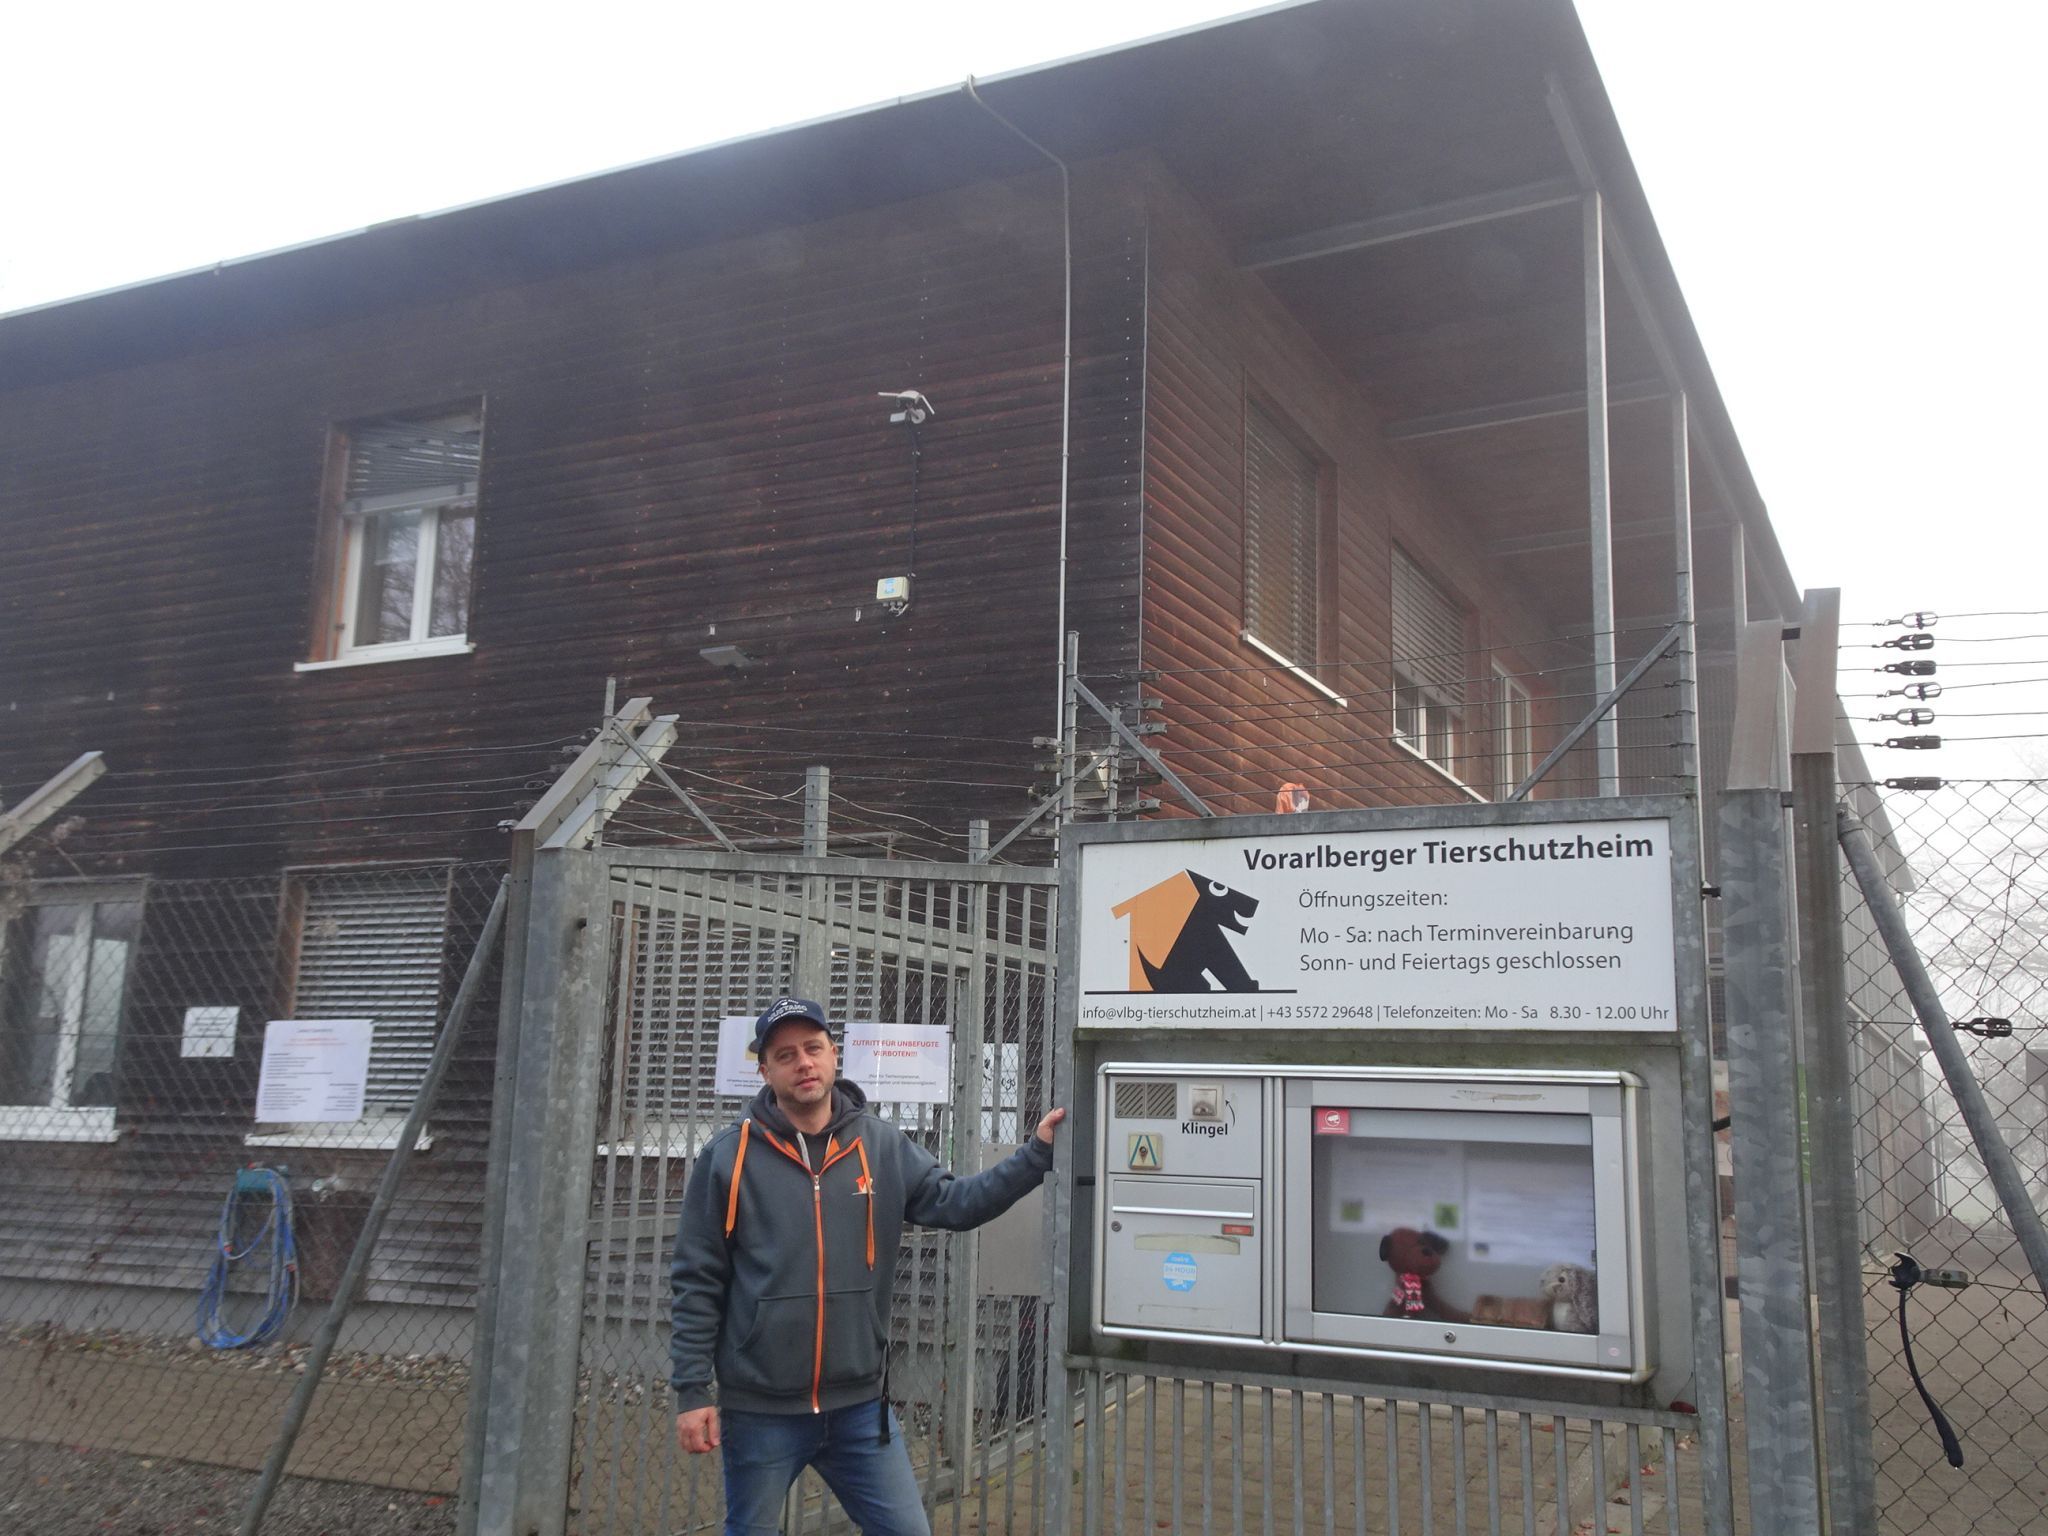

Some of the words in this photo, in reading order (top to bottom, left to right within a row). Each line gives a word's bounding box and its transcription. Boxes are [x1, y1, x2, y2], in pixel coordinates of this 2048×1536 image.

[1243, 841, 1418, 873] Vorarlberger
[1422, 834, 1654, 866] Tierschutzheim
[1298, 888, 1448, 912] Öffnungszeiten:
[1300, 928, 1329, 944] Mo
[1346, 926, 1373, 943] Sa:
[1377, 924, 1423, 943] nach
[1426, 922, 1634, 944] Terminvereinbarung
[1300, 955, 1355, 972] Sonn-
[1359, 953, 1396, 971] und
[1402, 953, 1490, 975] Feiertags
[1496, 951, 1622, 975] geschlossen
[1082, 1005, 1257, 1022] info@vlbg-tierschutzheim.at
[1267, 1005, 1292, 1019] +43
[1295, 1005, 1328, 1019] 5572
[1331, 1005, 1373, 1019] 29648
[1383, 1004, 1482, 1019] Telefonzeiten:
[1484, 1005, 1508, 1019] Mo
[1521, 1005, 1538, 1019] Sa
[1549, 1006, 1581, 1019] 8.30
[1595, 1006, 1637, 1020] 12.00
[1641, 1005, 1670, 1020] Uhr
[852, 1039, 880, 1047] ZUTRITT
[881, 1038, 896, 1047] FÜR
[897, 1040, 940, 1048] UNBEFUGTE
[1181, 1121, 1228, 1138] Klingel
